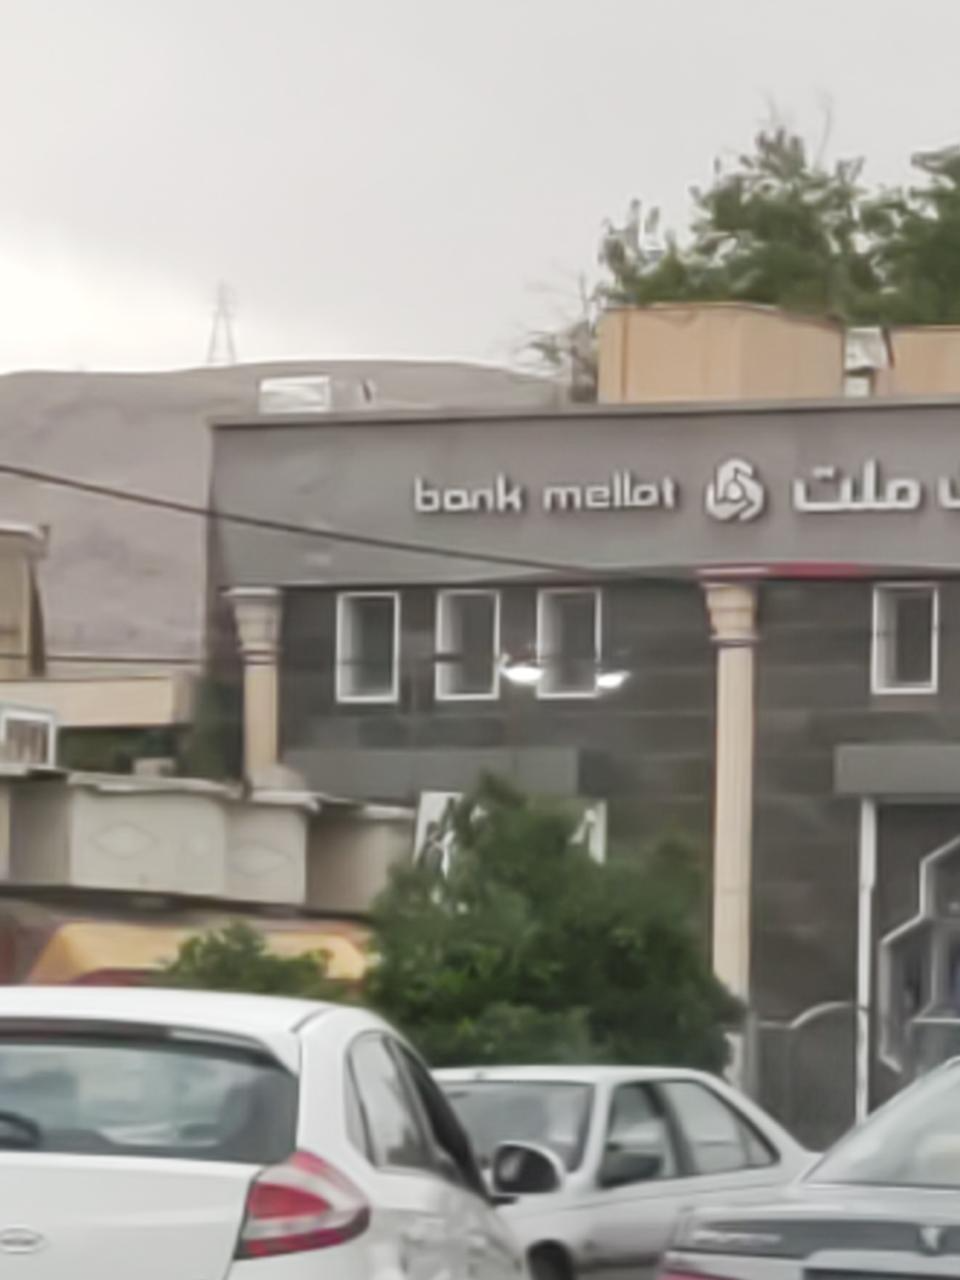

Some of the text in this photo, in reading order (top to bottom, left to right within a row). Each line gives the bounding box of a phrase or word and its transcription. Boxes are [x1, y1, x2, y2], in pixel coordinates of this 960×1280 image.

[414, 469, 679, 512] bank mellat
[792, 457, 921, 512] ملت
